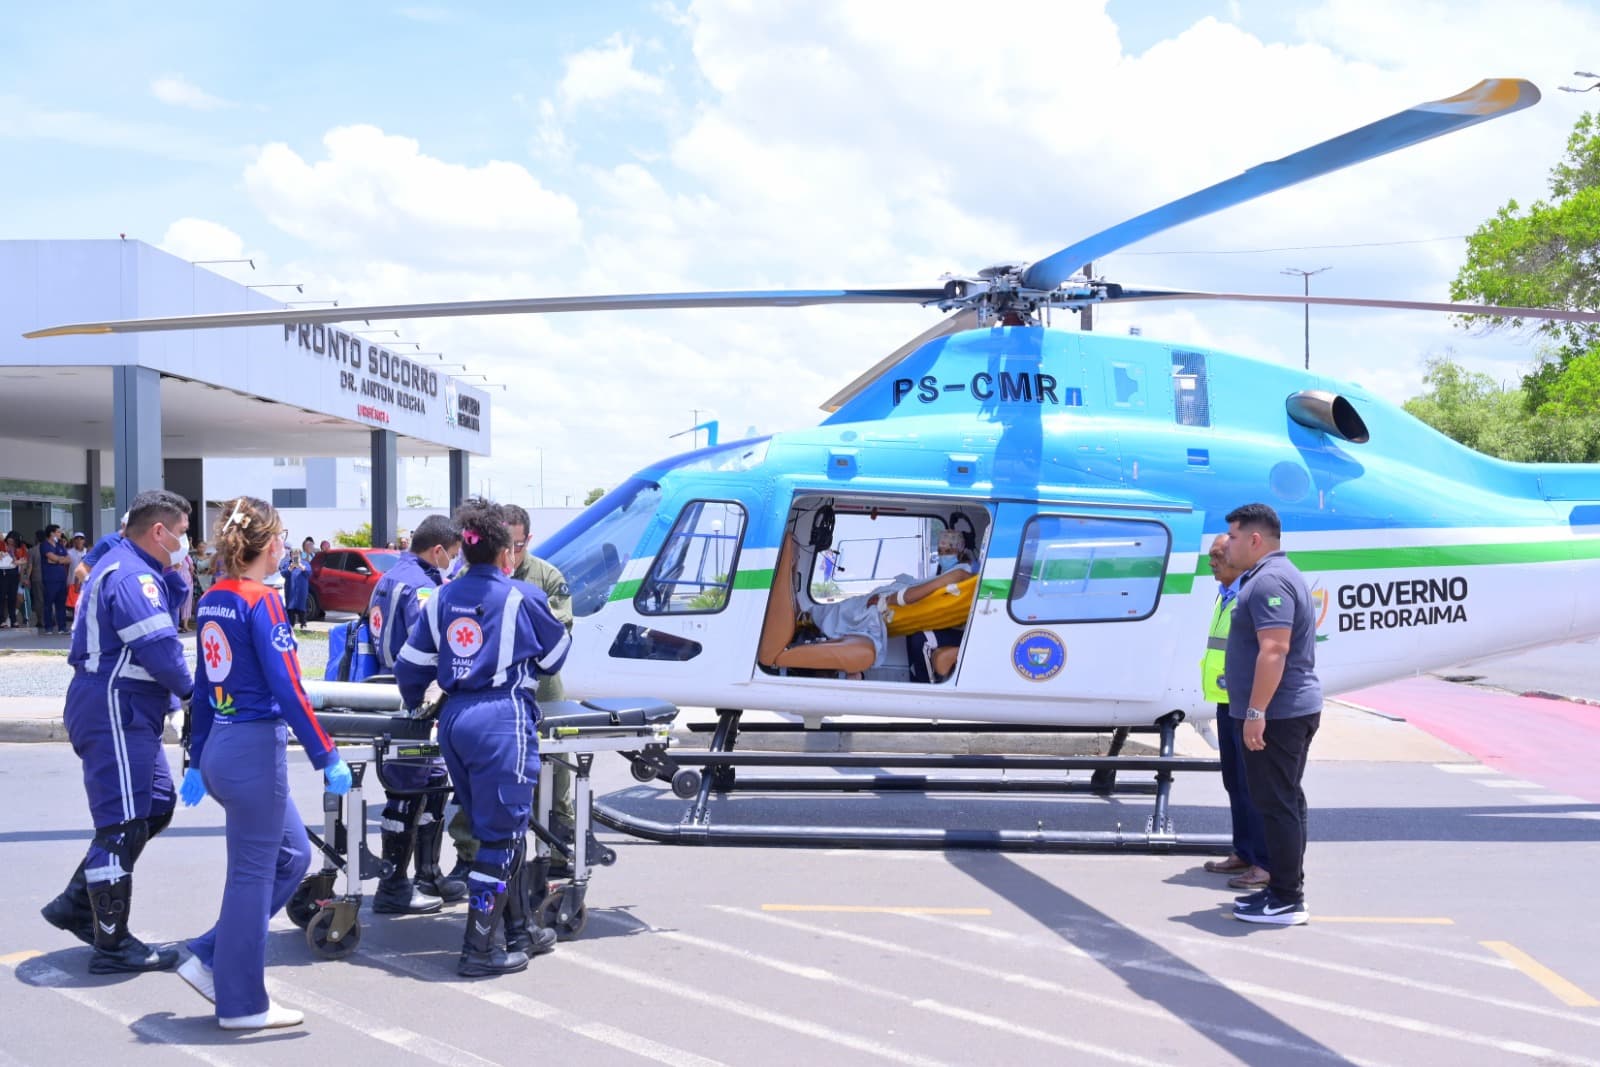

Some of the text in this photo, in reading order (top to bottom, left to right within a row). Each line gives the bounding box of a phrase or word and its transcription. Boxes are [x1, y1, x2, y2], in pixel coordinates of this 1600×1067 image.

[284, 322, 438, 398] PRONTO SOCORRO
[340, 370, 426, 416] DR. AIRTON ROCHA
[892, 372, 1060, 407] PS-CMR
[1337, 576, 1468, 610] GOVERNO
[1338, 604, 1468, 633] DE RORAIMA
[452, 657, 474, 667] SAMU
